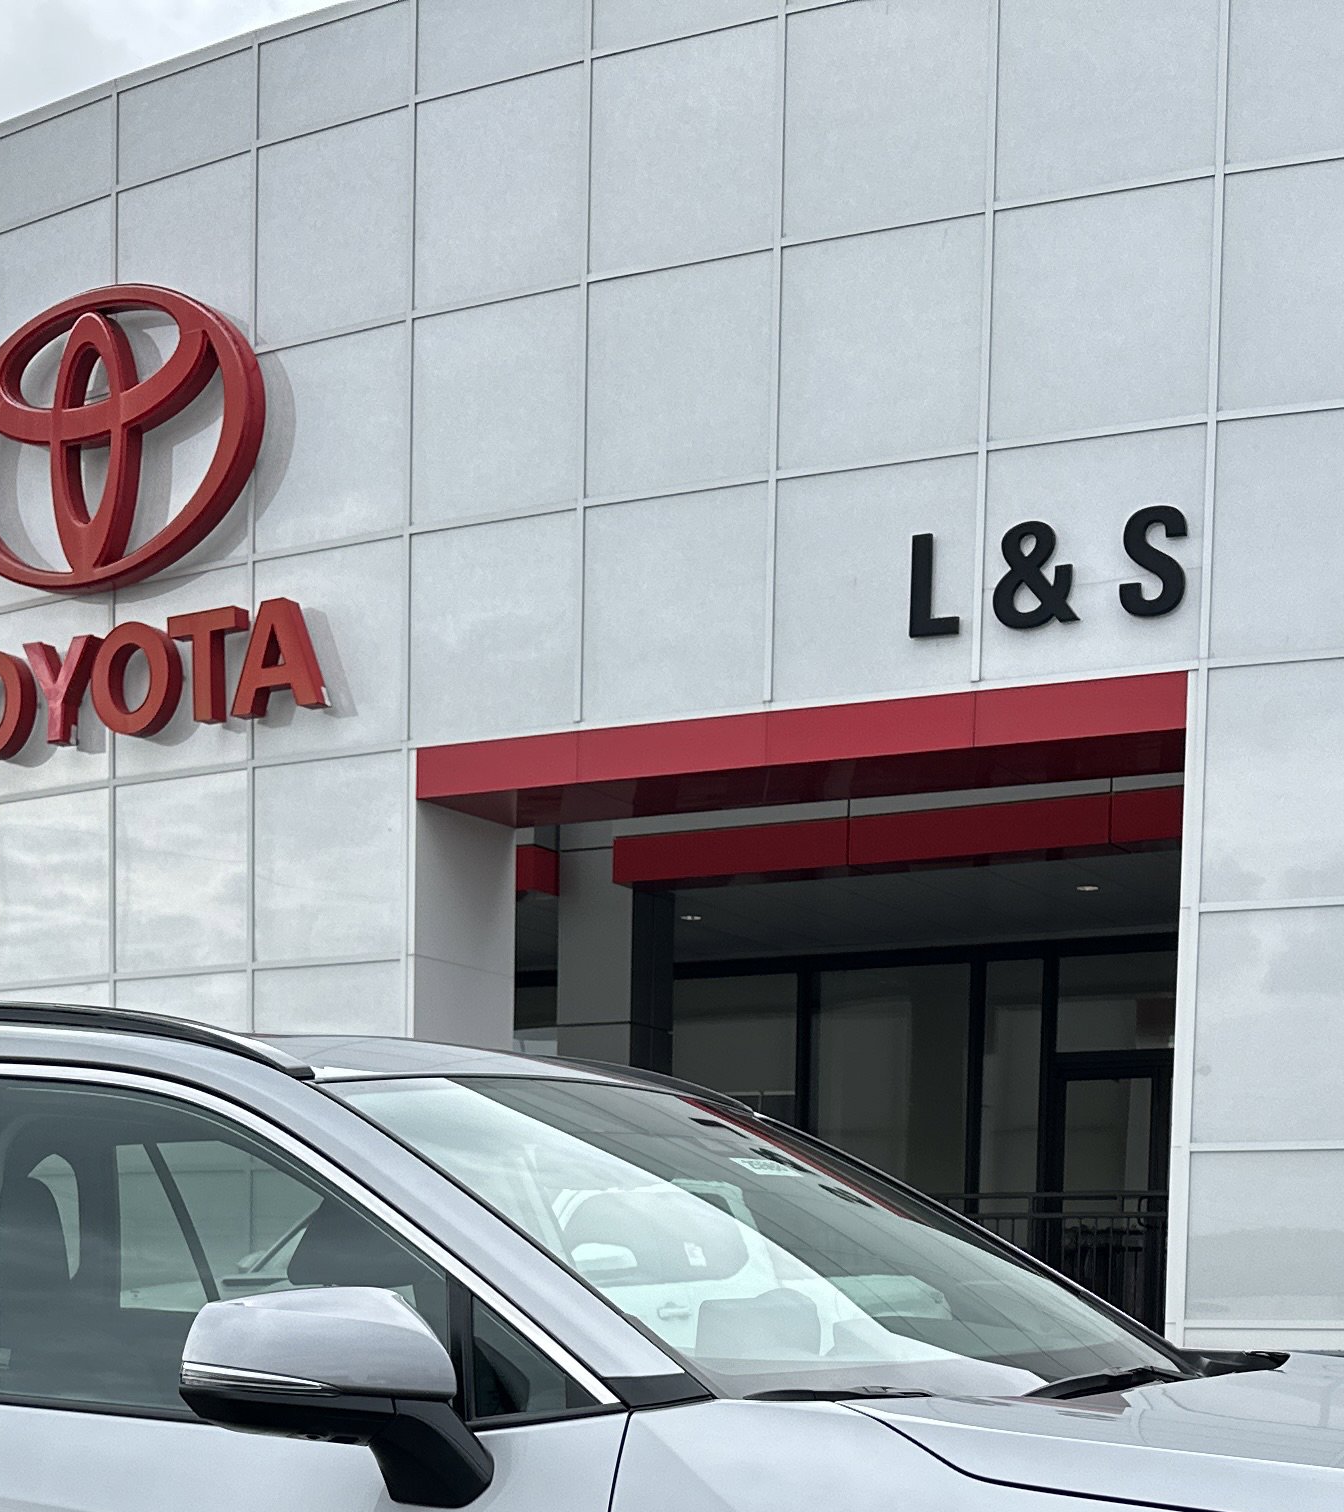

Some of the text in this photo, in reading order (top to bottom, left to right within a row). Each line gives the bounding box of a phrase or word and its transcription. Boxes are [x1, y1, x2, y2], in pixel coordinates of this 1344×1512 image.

[909, 505, 1188, 638] L & S
